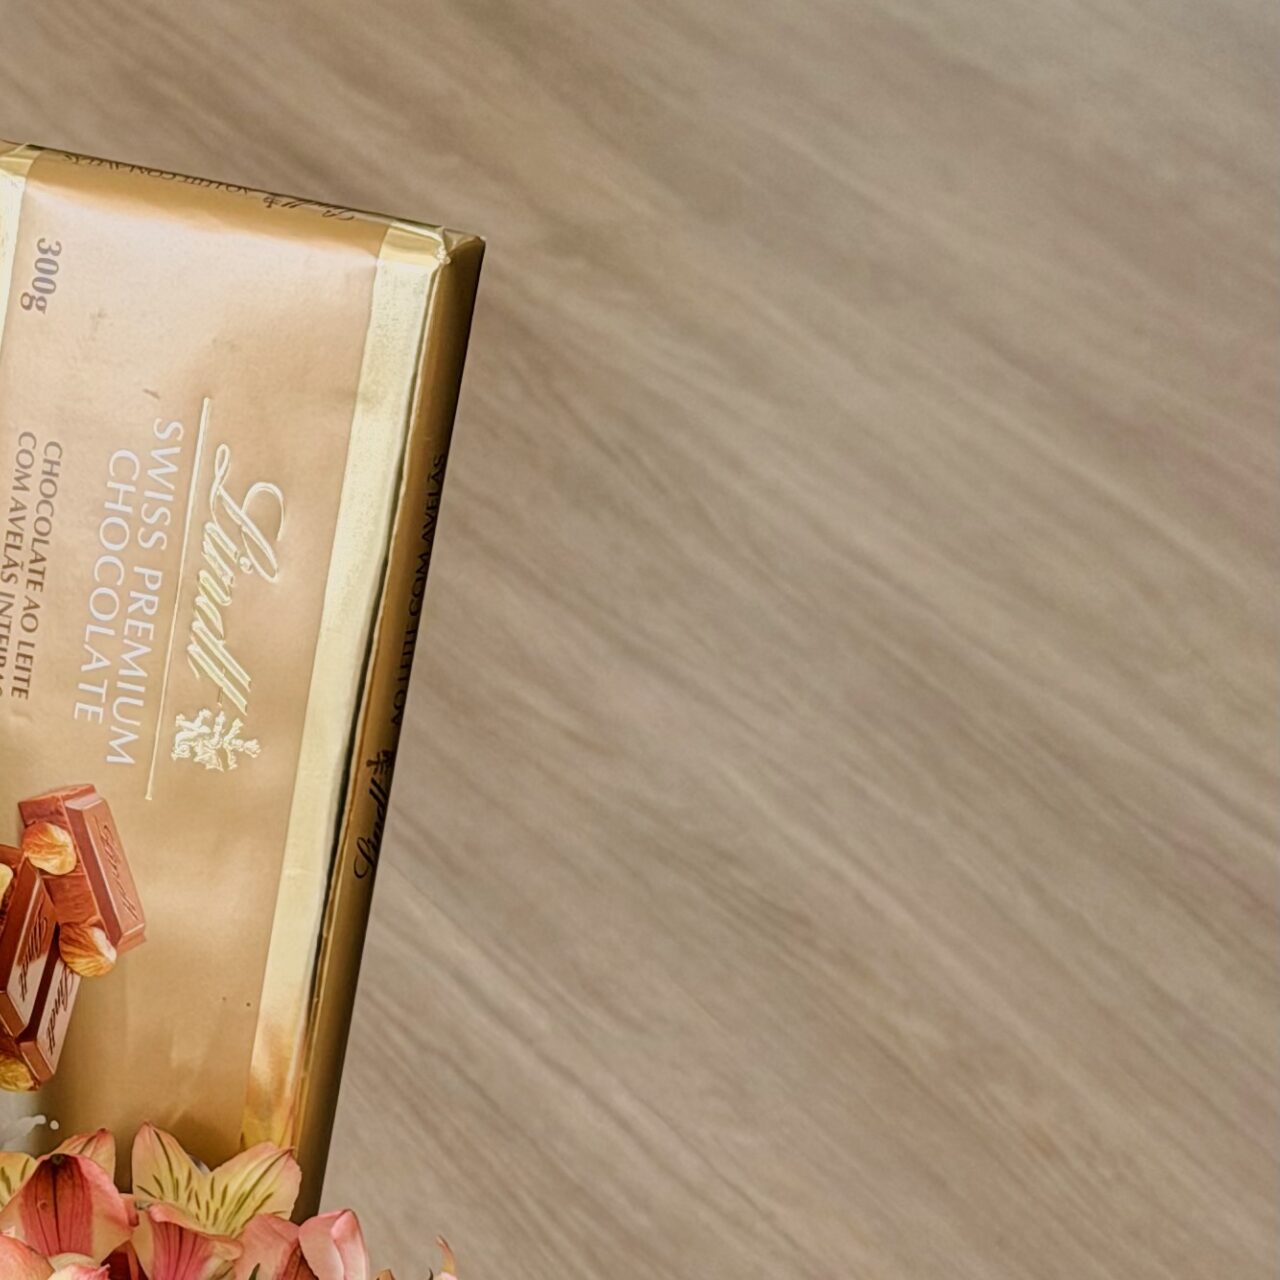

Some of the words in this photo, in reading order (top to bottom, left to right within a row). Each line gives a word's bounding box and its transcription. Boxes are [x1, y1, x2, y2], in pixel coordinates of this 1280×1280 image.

[19, 237, 62, 315] 300g
[12, 430, 37, 494] COM
[26, 440, 63, 594] CHOCOLATE
[137, 417, 184, 551] SWISS
[19, 595, 39, 634] AO
[73, 448, 140, 725] CHOCOLATE
[186, 443, 287, 716] Lindt
[11, 640, 36, 700] LEITE
[105, 566, 163, 765] PREMIUM
